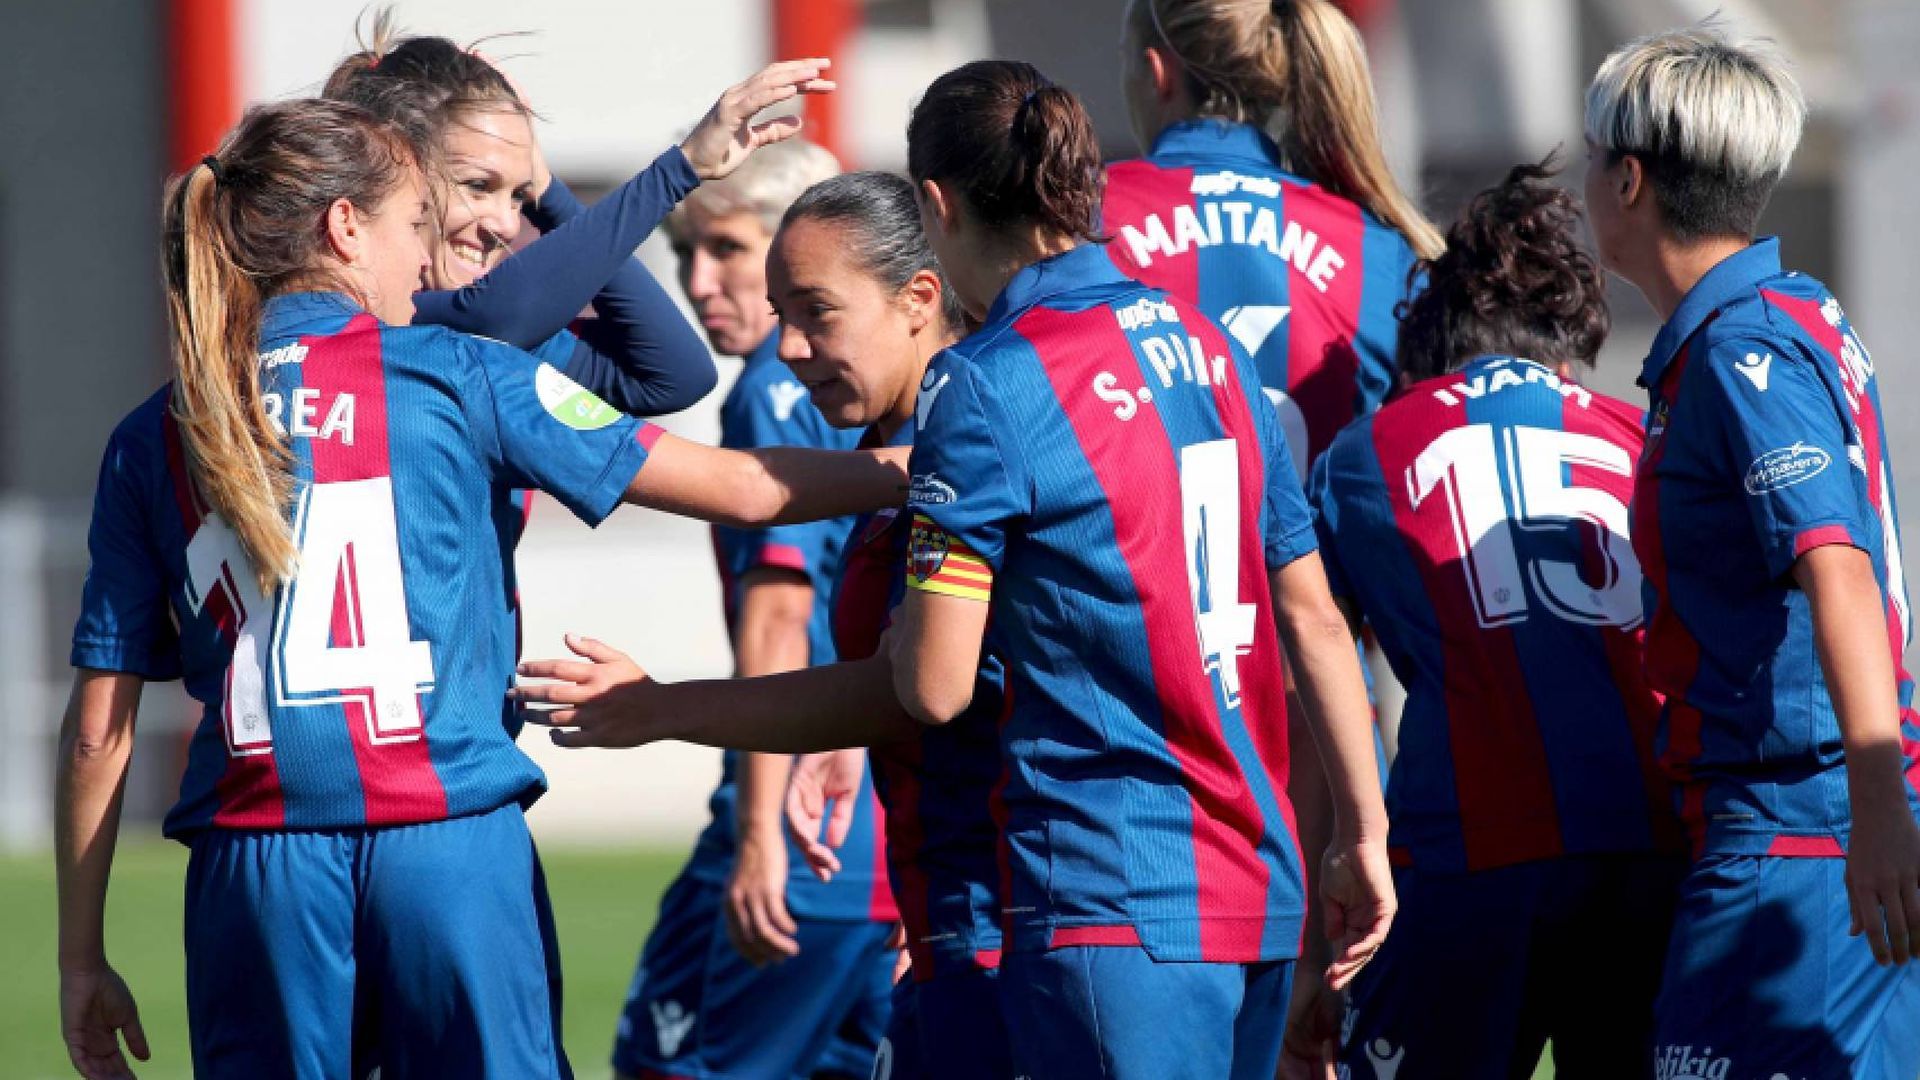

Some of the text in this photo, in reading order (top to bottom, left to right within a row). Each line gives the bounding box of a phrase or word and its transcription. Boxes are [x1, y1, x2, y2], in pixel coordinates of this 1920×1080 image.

[1120, 201, 1346, 293] MAITANE
[184, 475, 435, 757] 14
[1180, 437, 1258, 710] 4
[1405, 422, 1644, 631] 15
